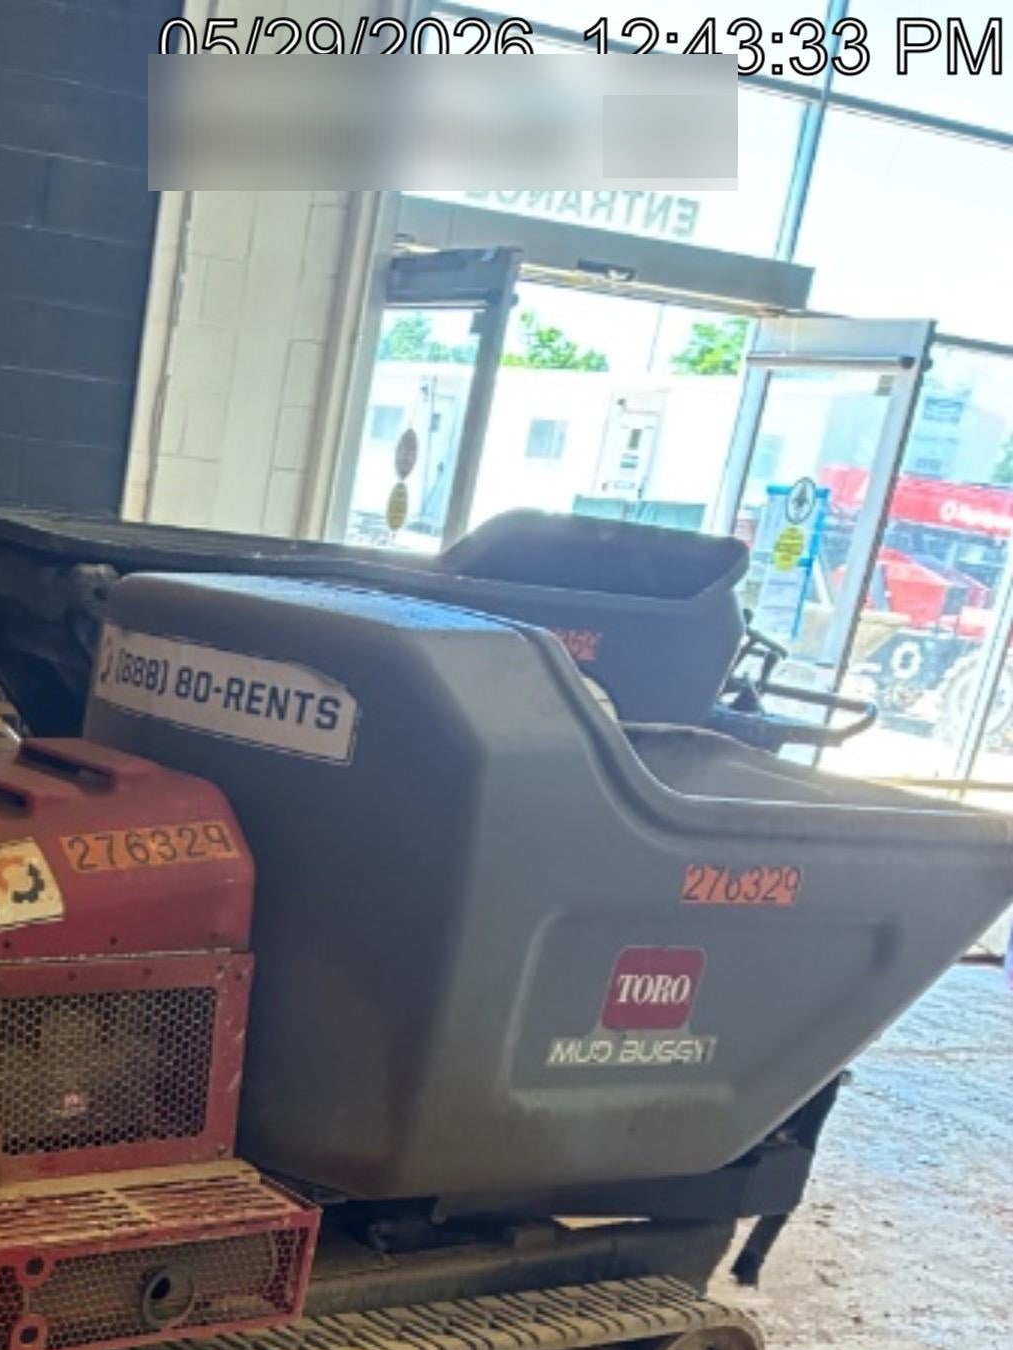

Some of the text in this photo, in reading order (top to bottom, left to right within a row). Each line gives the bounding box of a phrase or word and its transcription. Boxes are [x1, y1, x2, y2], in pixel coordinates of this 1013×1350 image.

[114, 648, 342, 730] (888) 80-RENTS
[67, 822, 232, 872] 276329
[682, 865, 802, 902] 276329
[617, 974, 691, 1005] TORO
[548, 1038, 613, 1064] MUD
